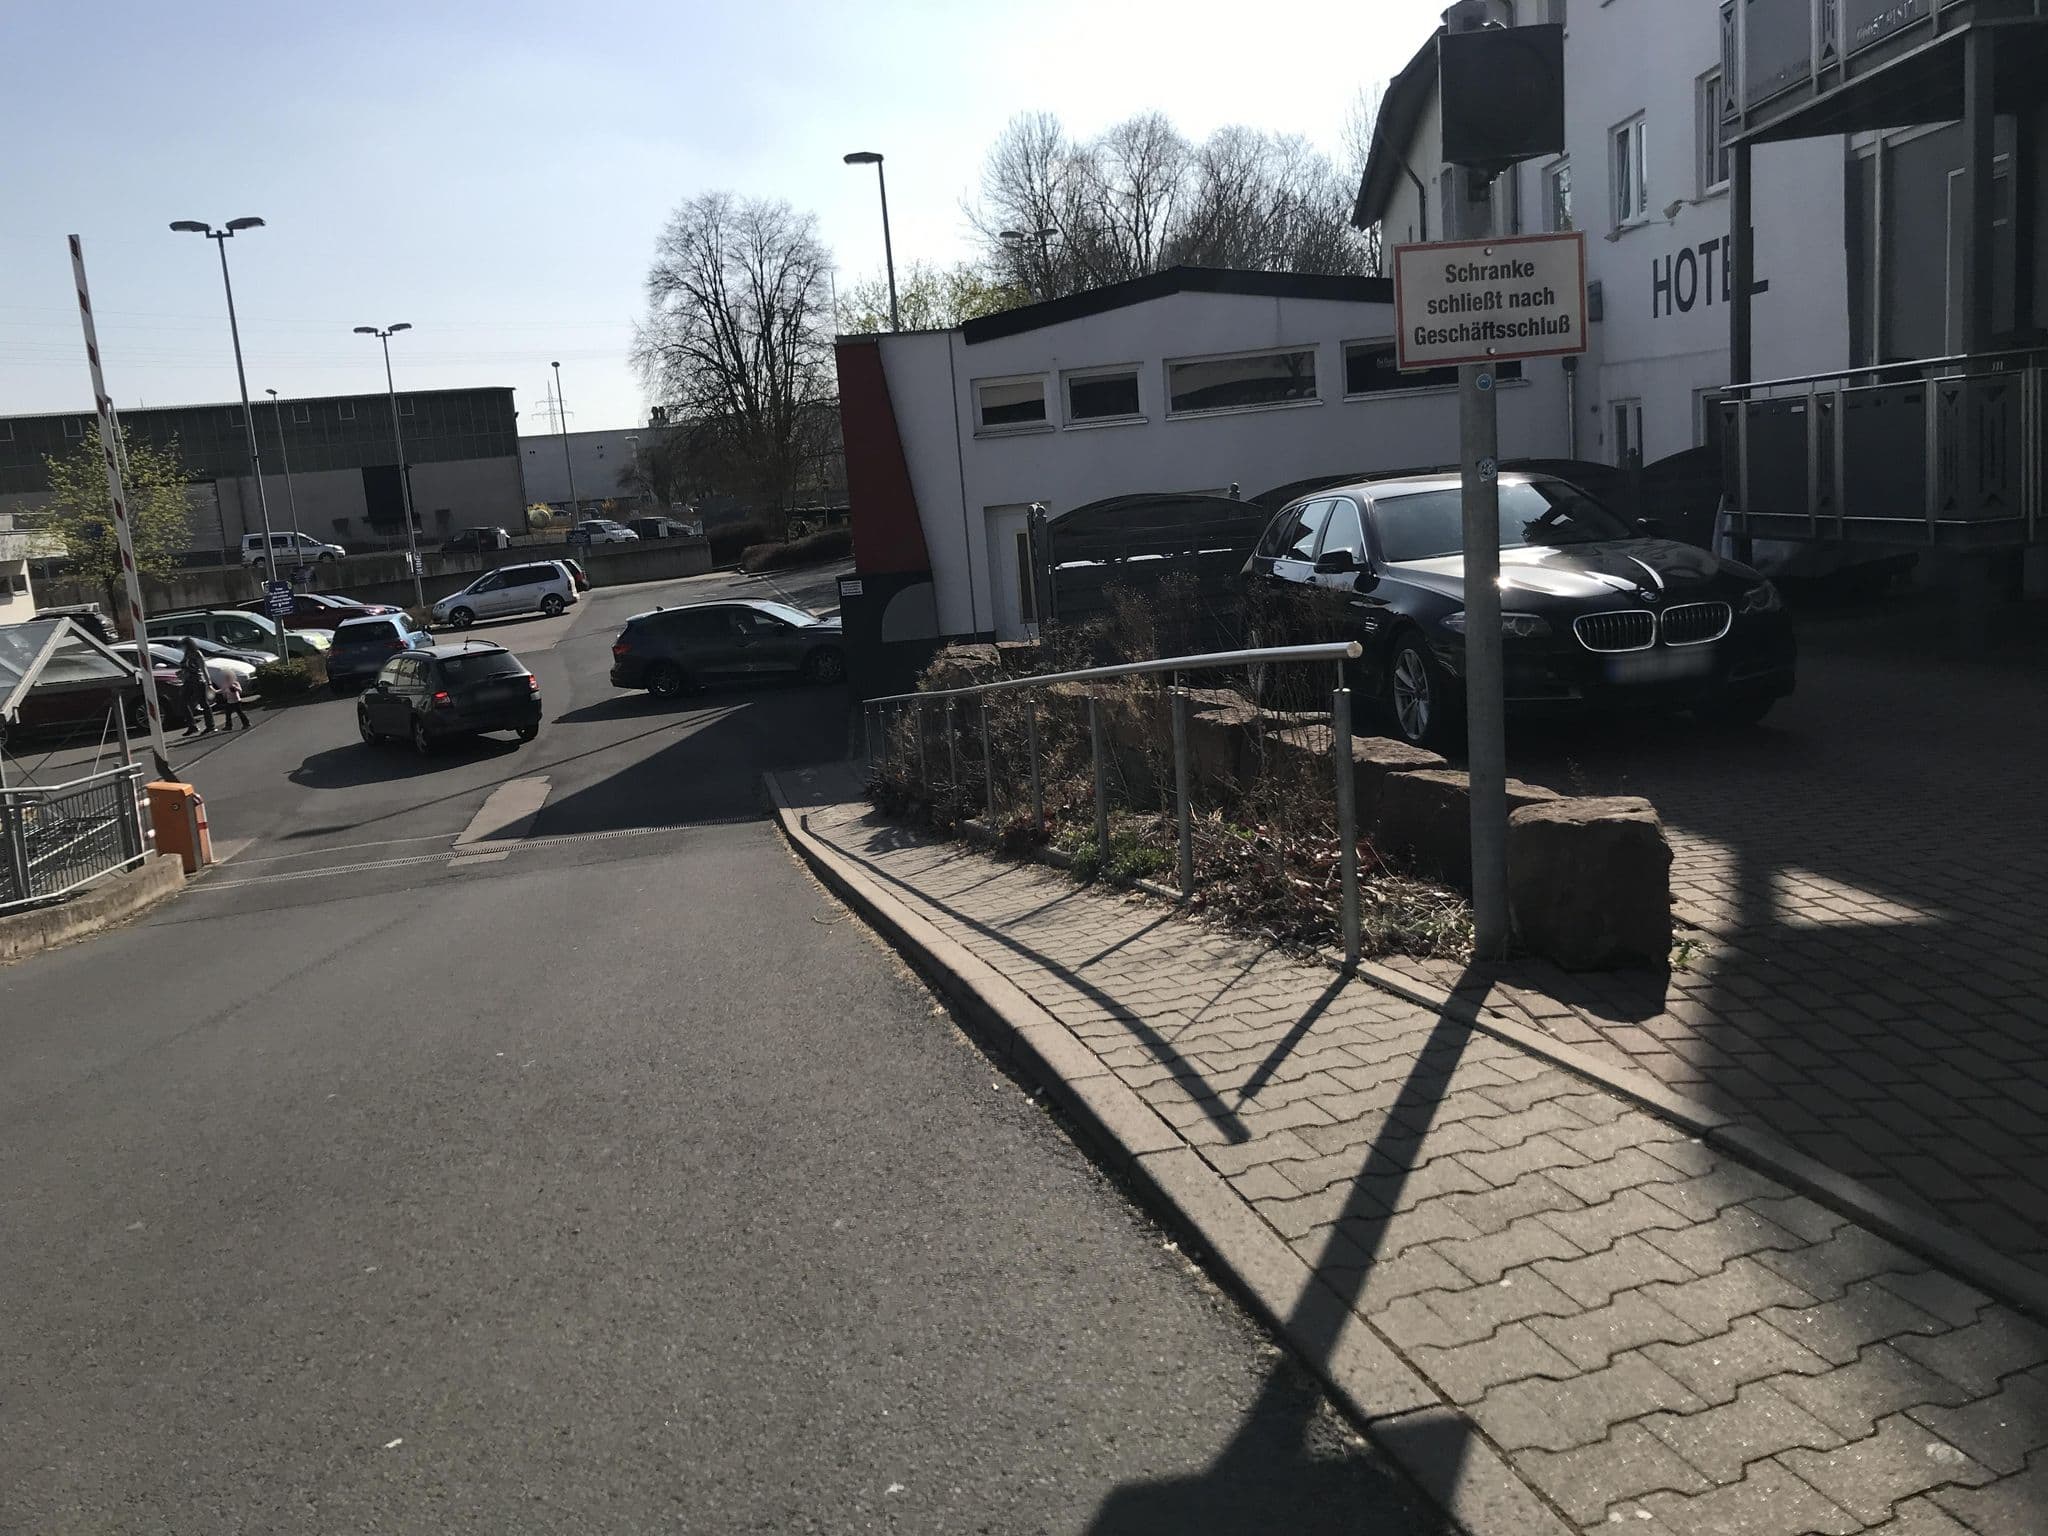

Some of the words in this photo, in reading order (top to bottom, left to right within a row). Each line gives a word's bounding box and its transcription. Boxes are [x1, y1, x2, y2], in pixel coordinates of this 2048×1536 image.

[1445, 259, 1535, 284] Schranke
[1427, 291, 1503, 315] schließt
[1509, 286, 1555, 309] nach
[1414, 314, 1570, 346] Geschäftsschluß
